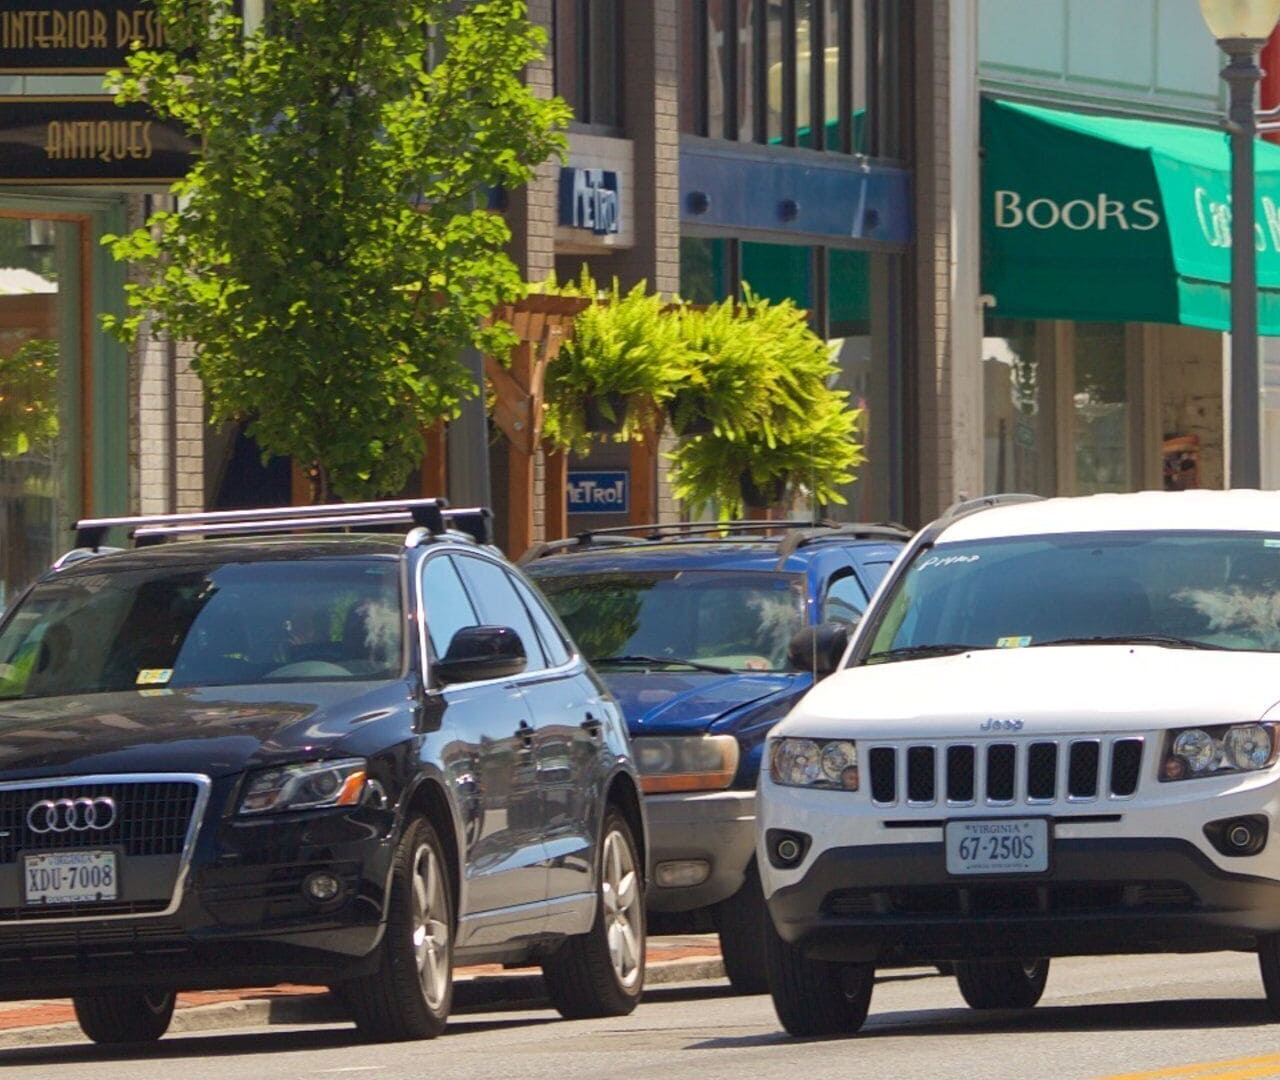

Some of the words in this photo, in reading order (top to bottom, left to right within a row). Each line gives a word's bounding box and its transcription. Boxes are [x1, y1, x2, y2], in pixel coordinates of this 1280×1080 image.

[2, 10, 107, 49] INTERIOR
[44, 121, 152, 161] ANTIQUES
[980, 717, 1024, 732] Jeep
[972, 824, 1022, 834] VIRGINIA
[959, 835, 1034, 861] 67-250S
[28, 865, 112, 892] XDU-7008
